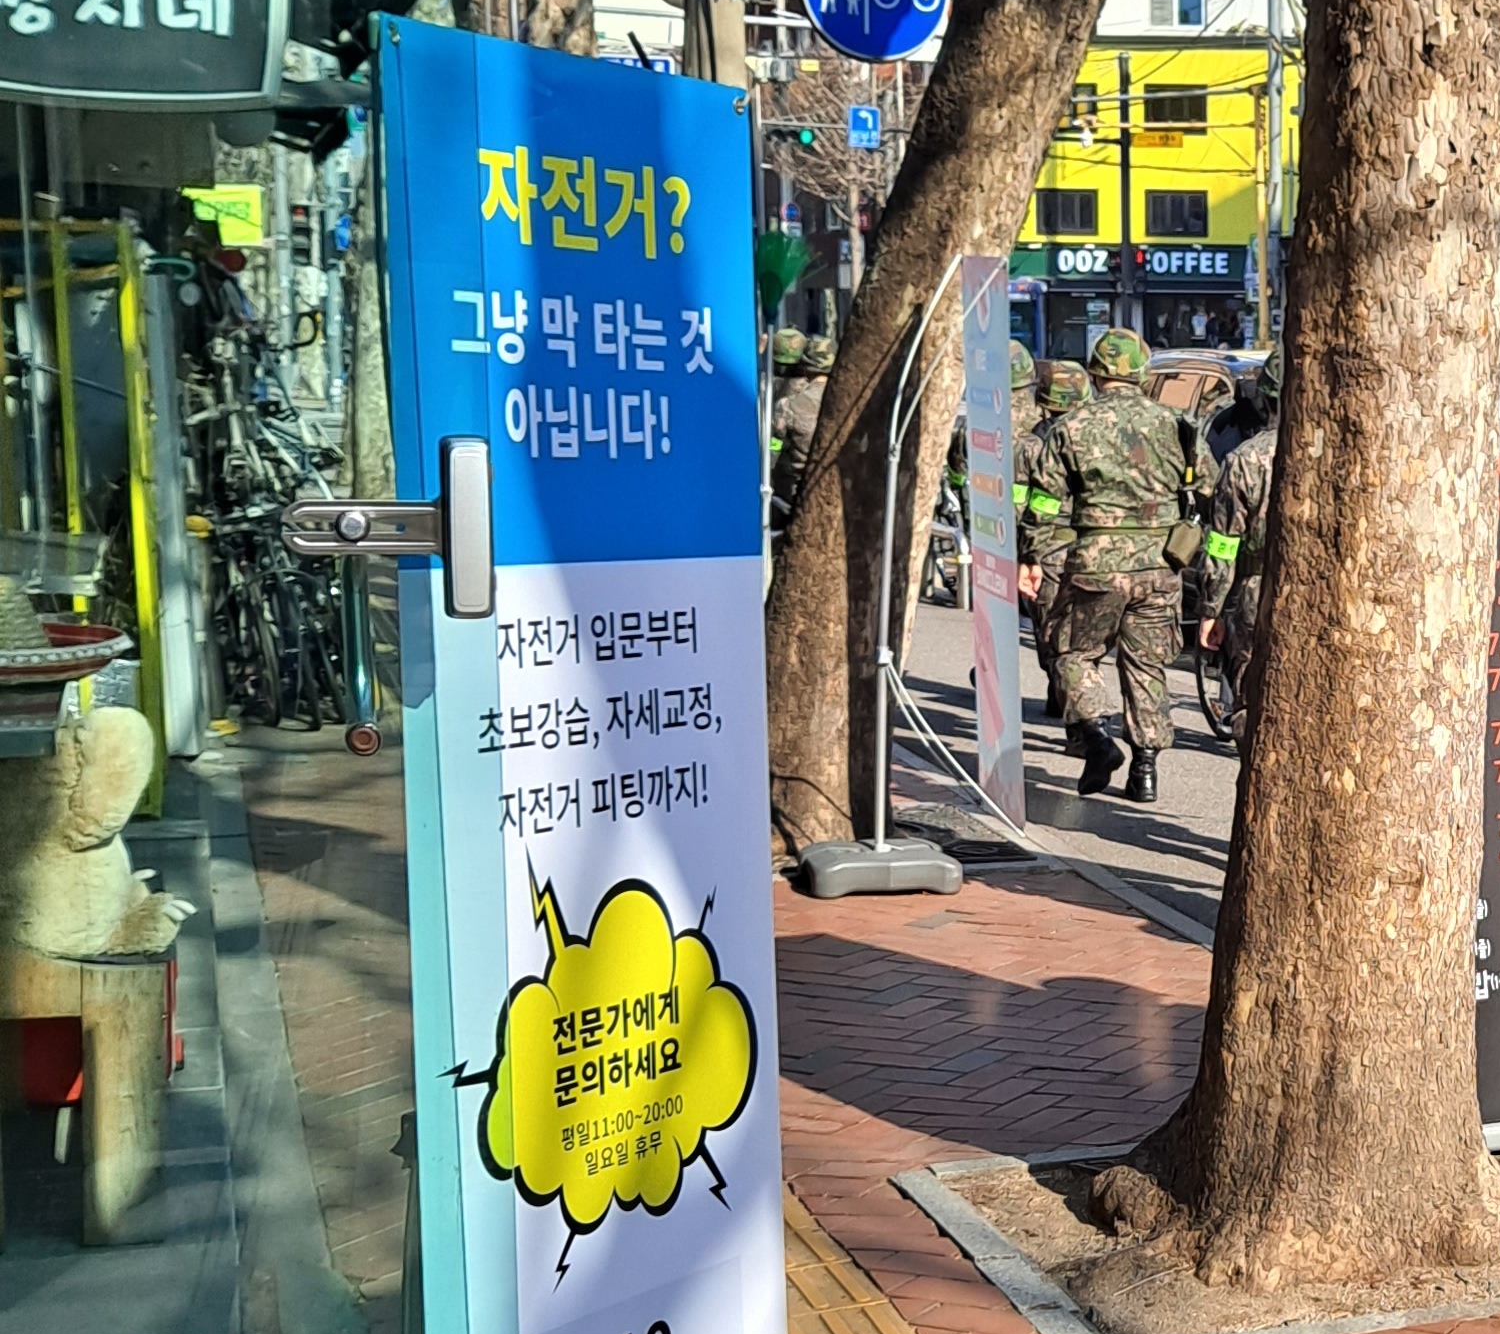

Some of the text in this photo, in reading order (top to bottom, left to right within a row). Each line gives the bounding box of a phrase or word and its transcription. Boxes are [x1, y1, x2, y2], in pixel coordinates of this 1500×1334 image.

[478, 145, 691, 259] 자전거?
[1145, 251, 1229, 274] OFFEE
[451, 289, 714, 375] 그냥 막 타는 것
[505, 384, 672, 460] 아닙니다!
[498, 606, 698, 669] 자전거 입문부터
[477, 682, 723, 754] 초보강습, 자세교정,
[497, 761, 708, 838] 자전거 피팅까지!
[553, 985, 680, 1056] 전문가에게
[553, 1037, 682, 1108] 문의하세요
[584, 1130, 663, 1176] 일요일 휴무
